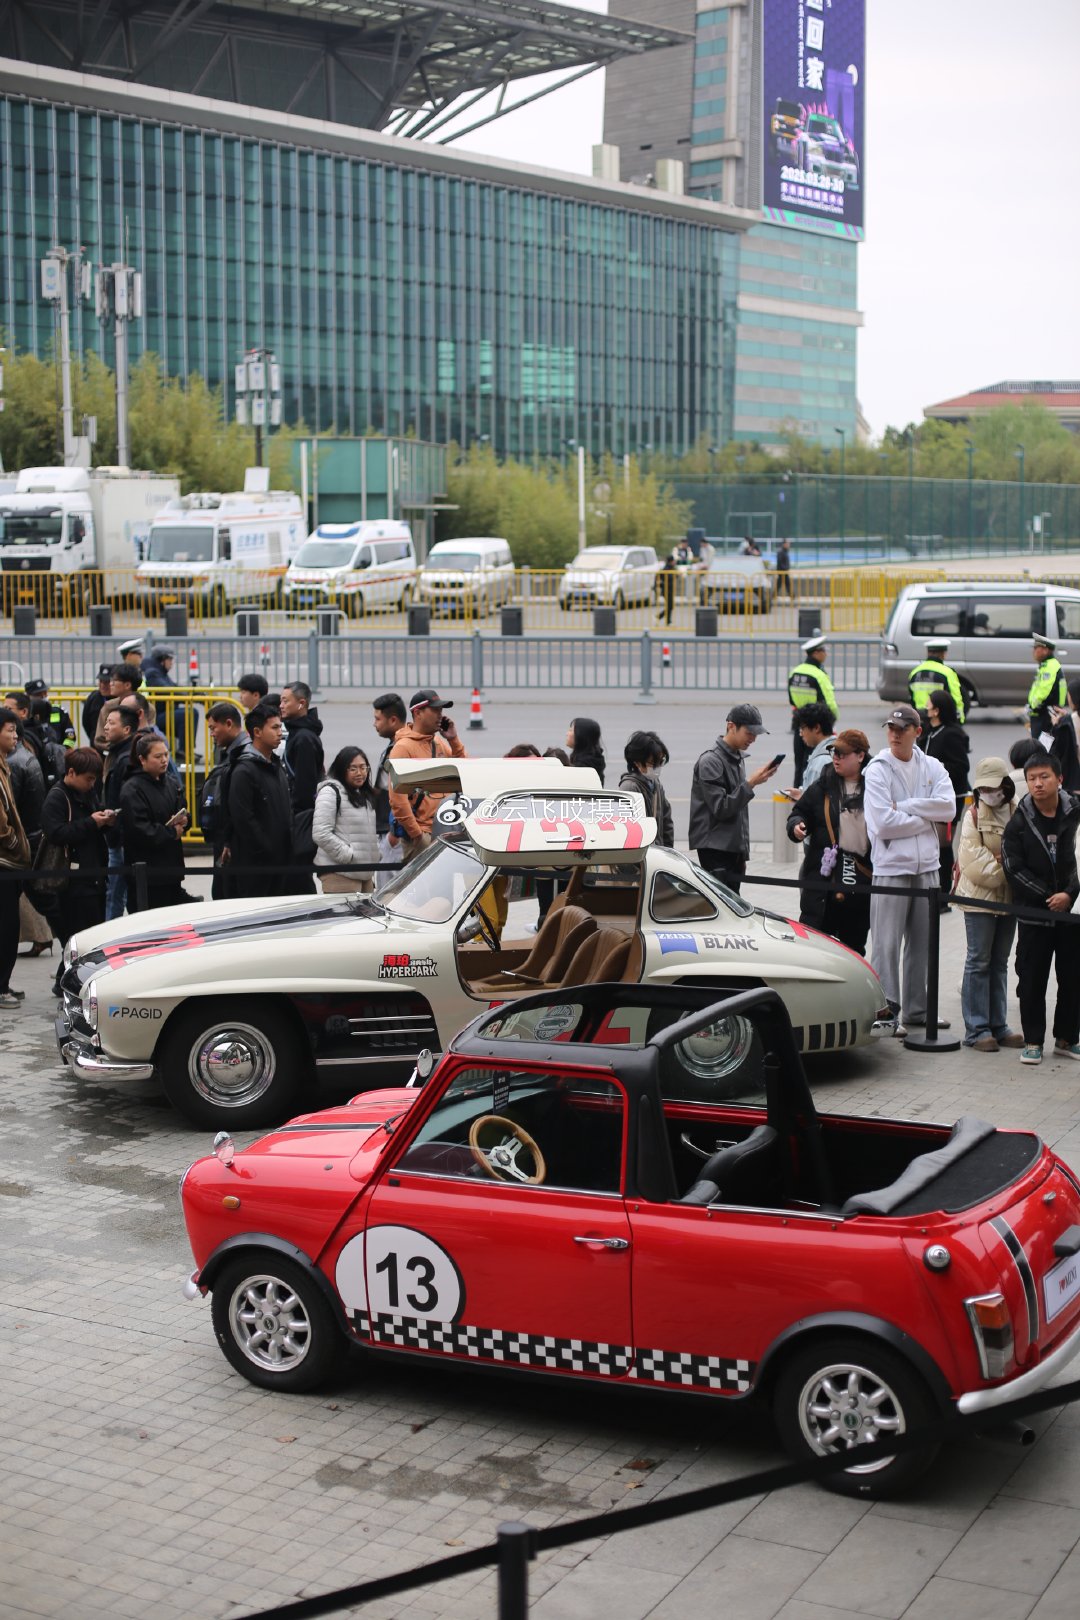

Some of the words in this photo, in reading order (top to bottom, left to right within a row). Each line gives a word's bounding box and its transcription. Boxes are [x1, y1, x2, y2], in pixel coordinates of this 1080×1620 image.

[704, 937, 759, 951] BLANC
[379, 963, 437, 978] HYPERPARK
[121, 1007, 162, 1019] PAGID
[375, 1252, 439, 1312] 13
